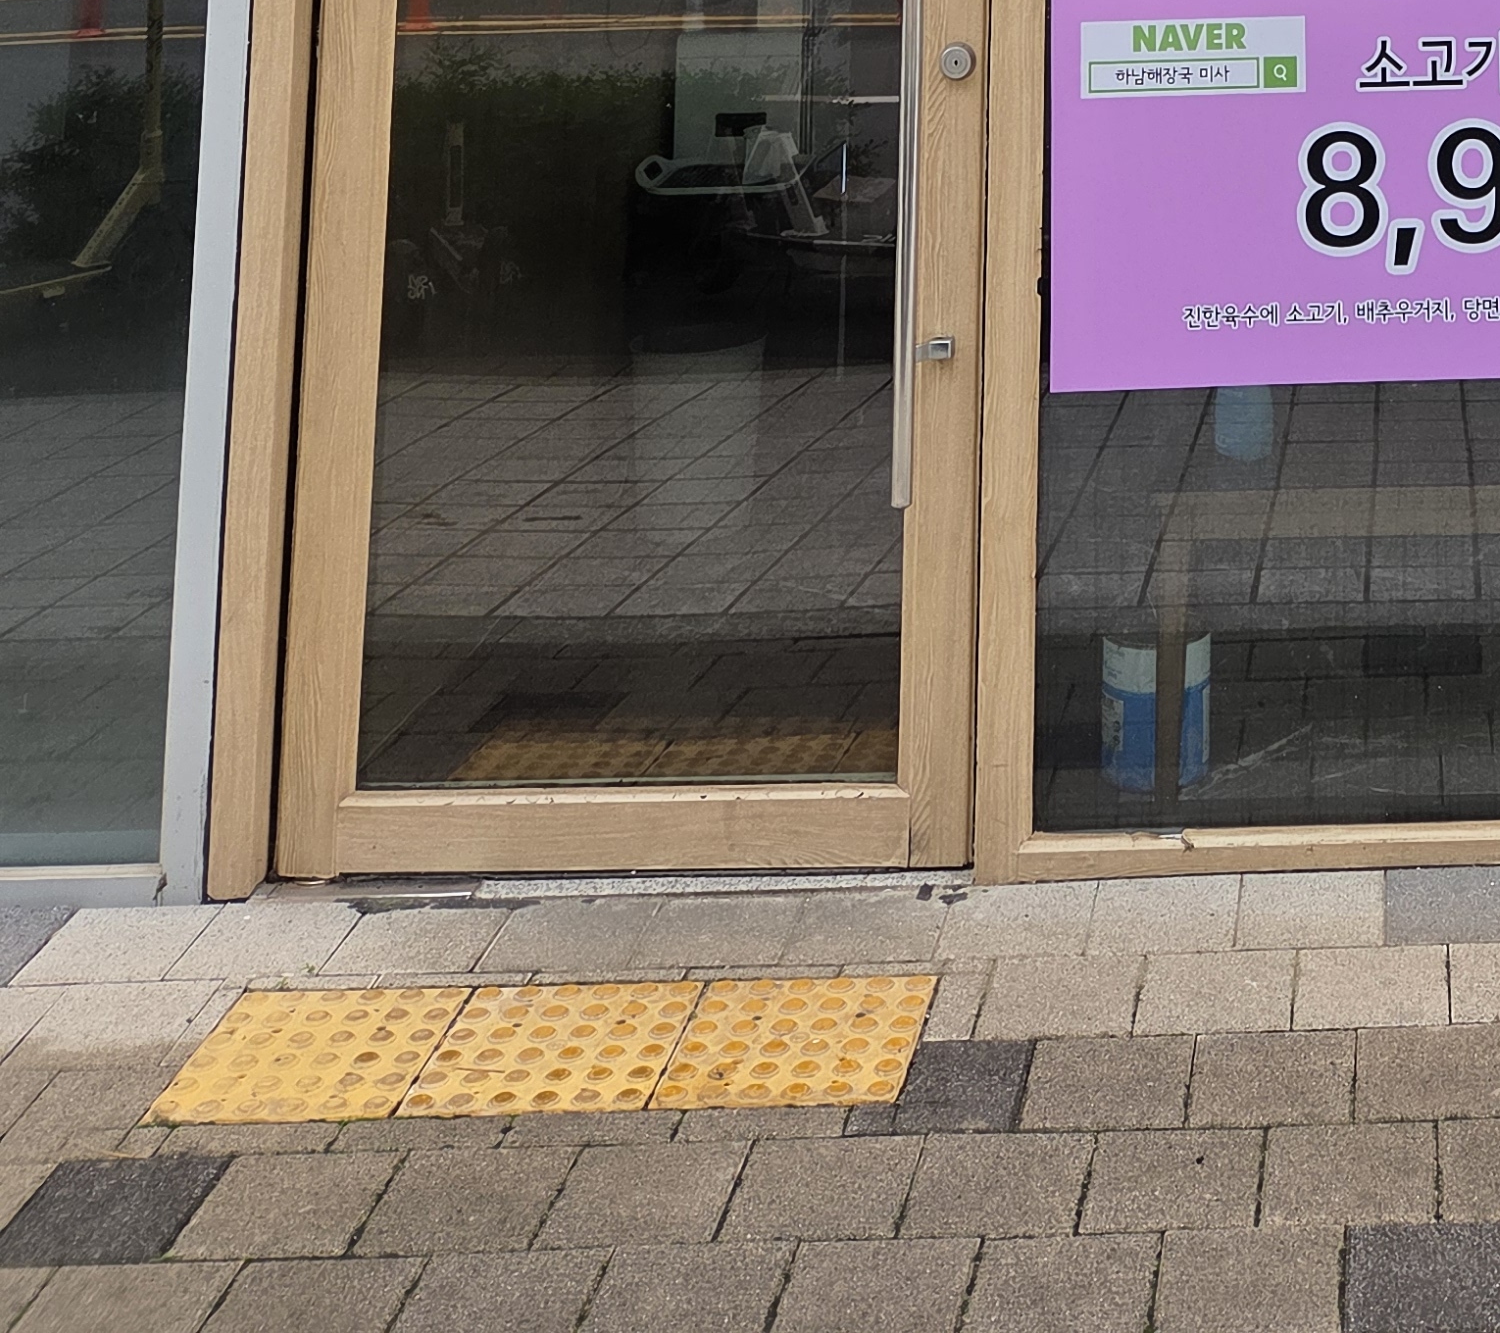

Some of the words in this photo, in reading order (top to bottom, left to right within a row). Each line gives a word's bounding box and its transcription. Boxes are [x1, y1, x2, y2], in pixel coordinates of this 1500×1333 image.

[1132, 22, 1247, 53] NAVER
[1114, 66, 1194, 86] 하남해장국
[1199, 64, 1231, 83] 미사
[1183, 303, 1279, 328] 진한육수에
[1286, 302, 1348, 324] 소고기,
[1356, 298, 1455, 322] 배추우거지,
